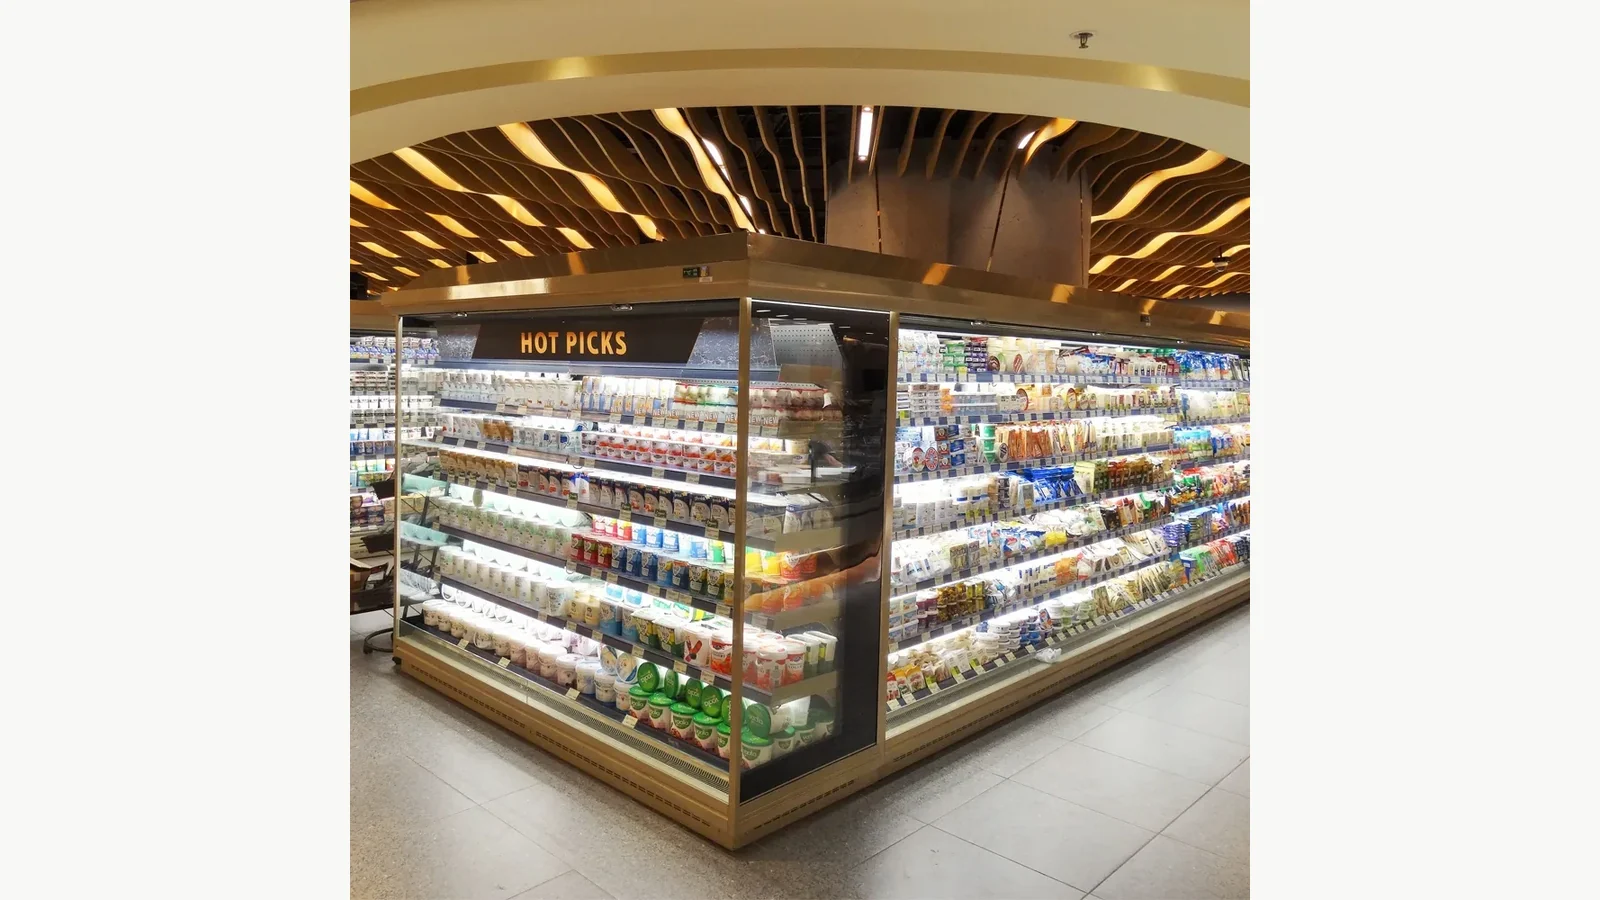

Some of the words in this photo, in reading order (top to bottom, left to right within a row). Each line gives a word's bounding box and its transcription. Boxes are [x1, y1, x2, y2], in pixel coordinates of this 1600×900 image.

[521, 332, 559, 354] HOT
[566, 331, 628, 355] PICKS
[686, 410, 700, 420] NEW
[704, 411, 718, 421] NEW
[763, 416, 779, 425] NEW
